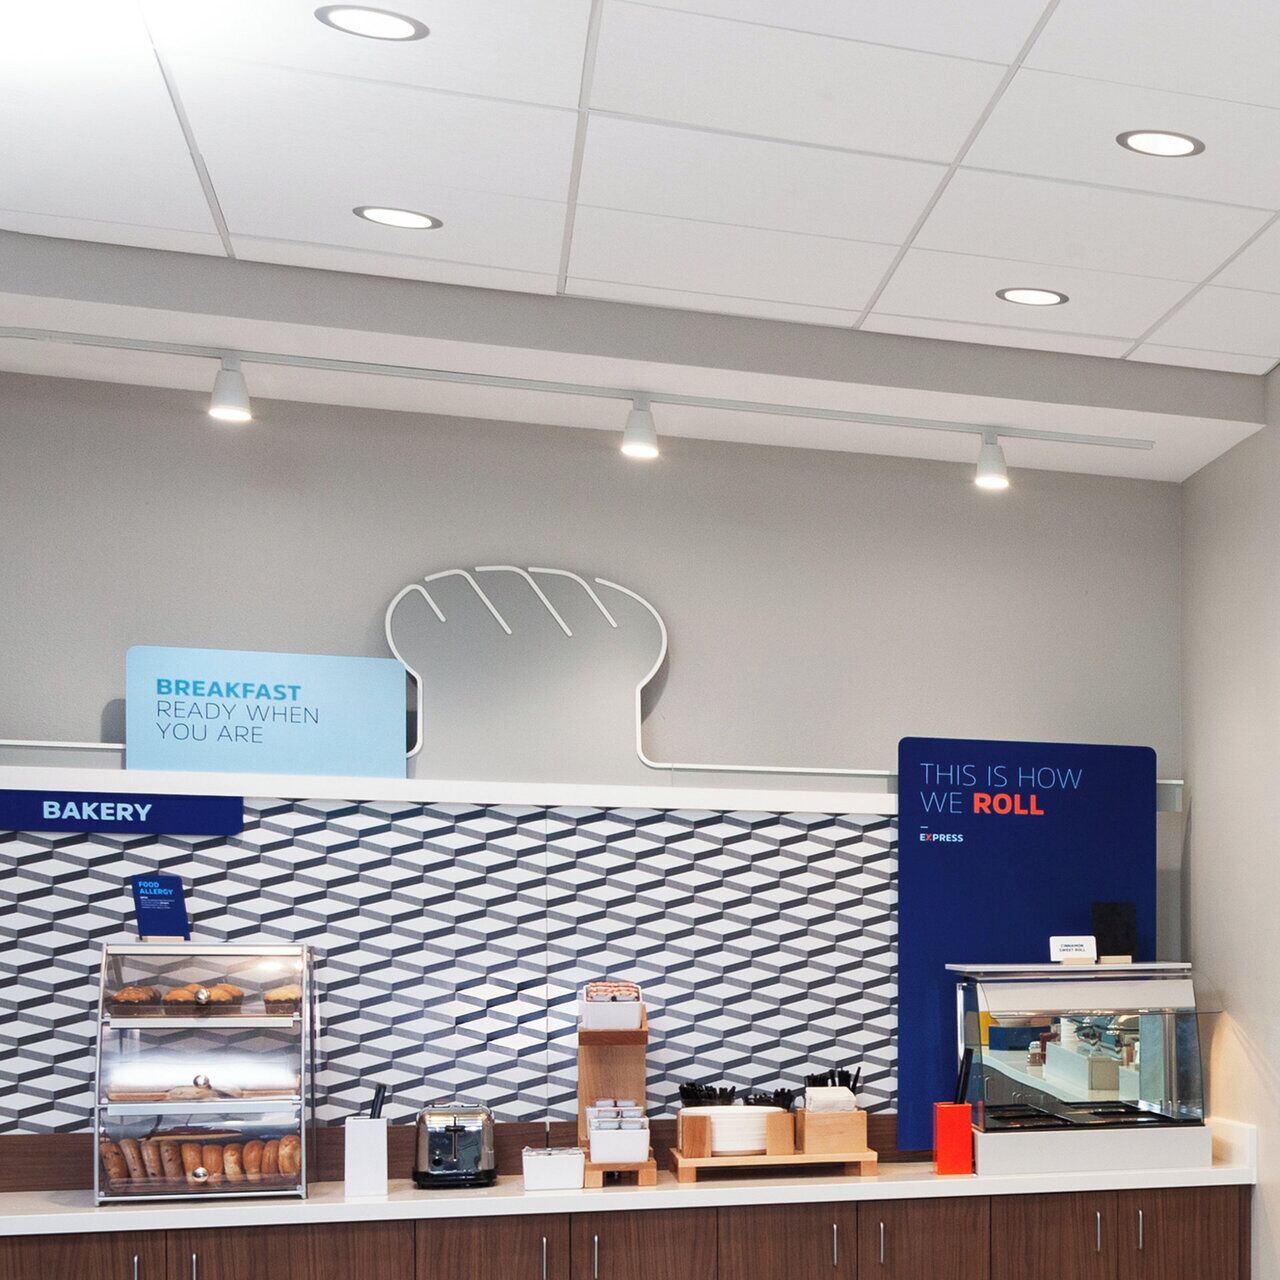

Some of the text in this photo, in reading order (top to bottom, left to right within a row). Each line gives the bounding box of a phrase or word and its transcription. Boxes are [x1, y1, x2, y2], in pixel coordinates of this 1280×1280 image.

[156, 678, 302, 701] BREAKFAST
[156, 700, 320, 724] READY WHEN
[156, 723, 264, 743] YOU ARE
[920, 763, 1083, 790] THIS IS HOW
[42, 801, 152, 822] BAKERY
[920, 792, 1045, 816] WE ROLL
[919, 833, 964, 843] EXPRESS
[139, 888, 174, 896] ALLERGY
